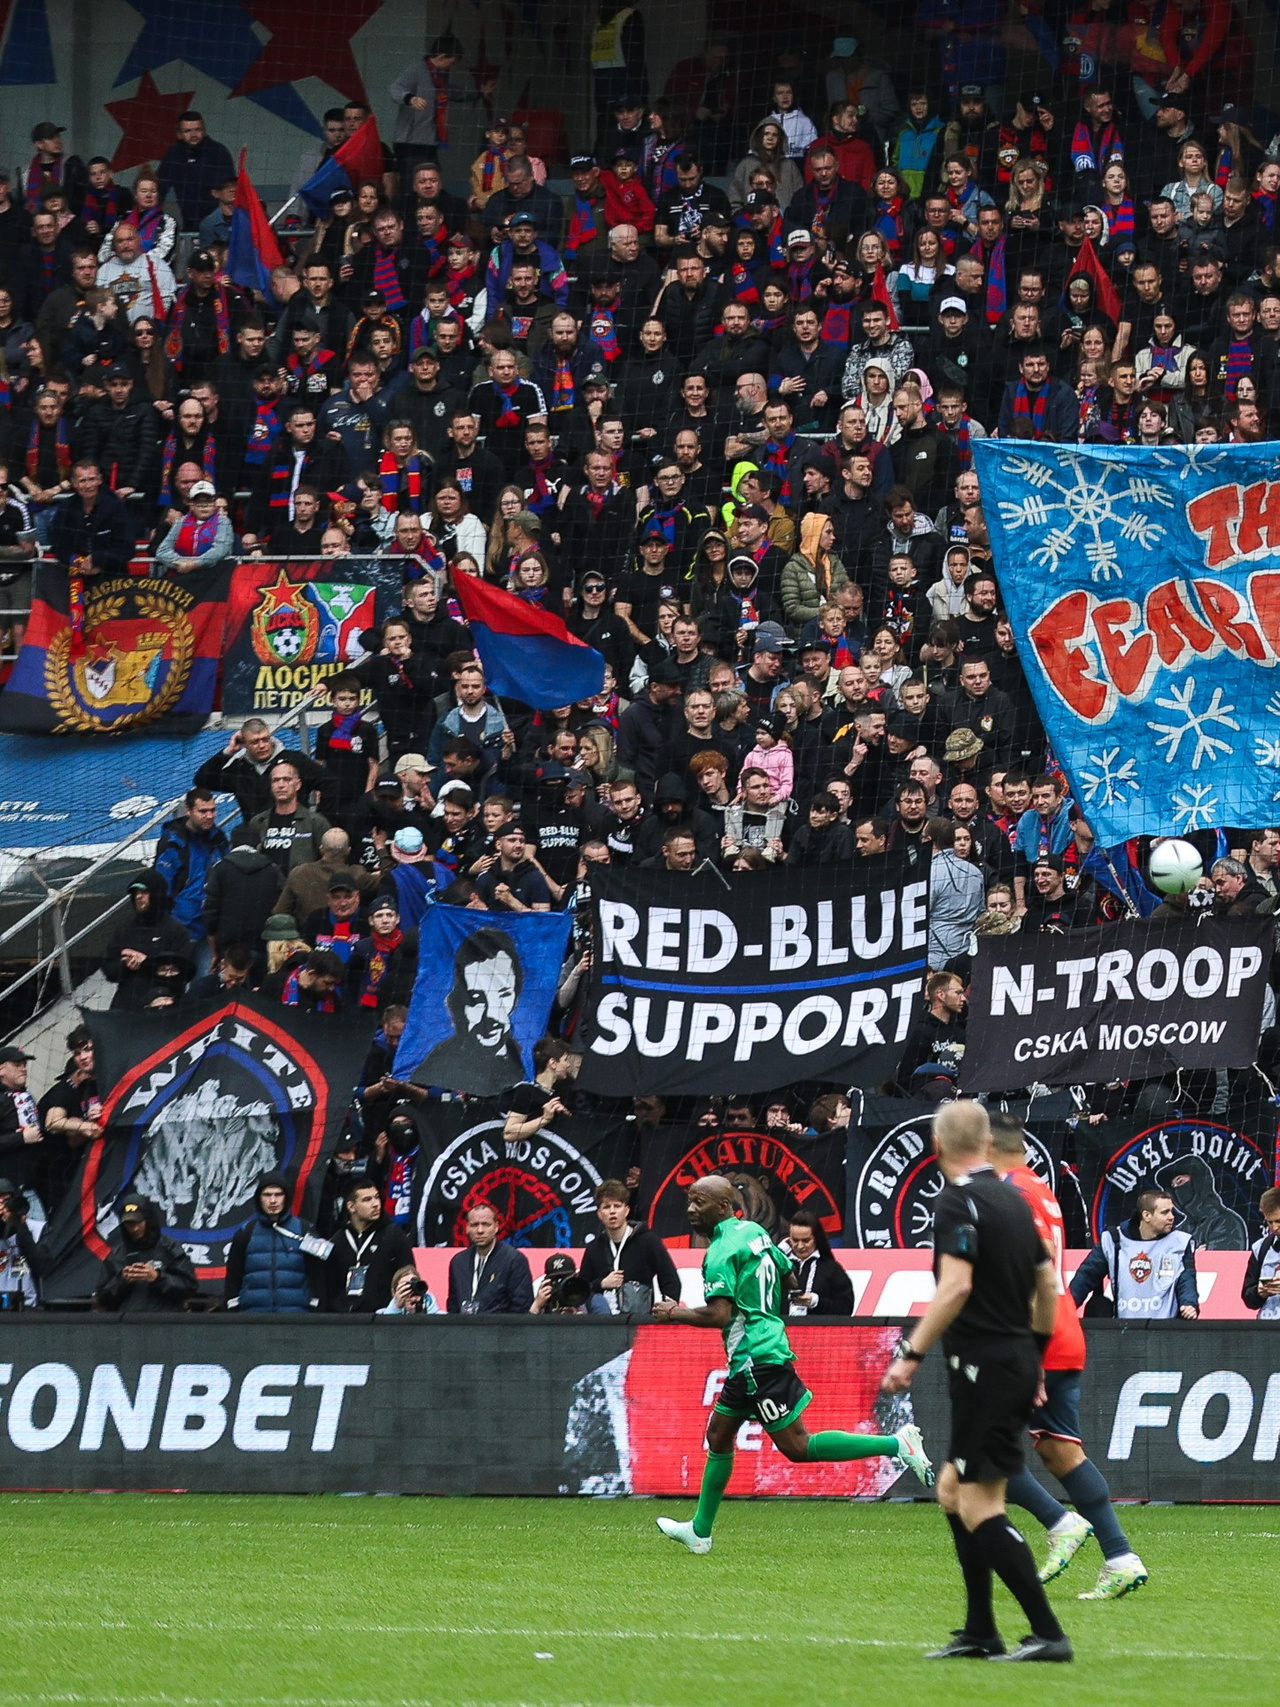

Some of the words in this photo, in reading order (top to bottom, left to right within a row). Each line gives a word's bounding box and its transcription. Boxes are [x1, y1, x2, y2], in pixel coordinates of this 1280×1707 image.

[540, 838, 579, 849] SUPPOR
[599, 880, 928, 974] RED-BLUE
[989, 946, 1263, 1016] N-TROOP
[590, 977, 923, 1063] SUPPORT
[1013, 1025, 1088, 1062] CSKA
[1098, 1020, 1227, 1052] MOSCOW
[122, 1022, 313, 1113] WHITE
[440, 1140, 499, 1200] CSKA
[504, 1140, 598, 1215] MOSCOW
[675, 1137, 819, 1204] SHATURA
[867, 1130, 925, 1199] RED
[1118, 1295, 1162, 1313] ФОТО
[757, 1398, 780, 1424] 10
